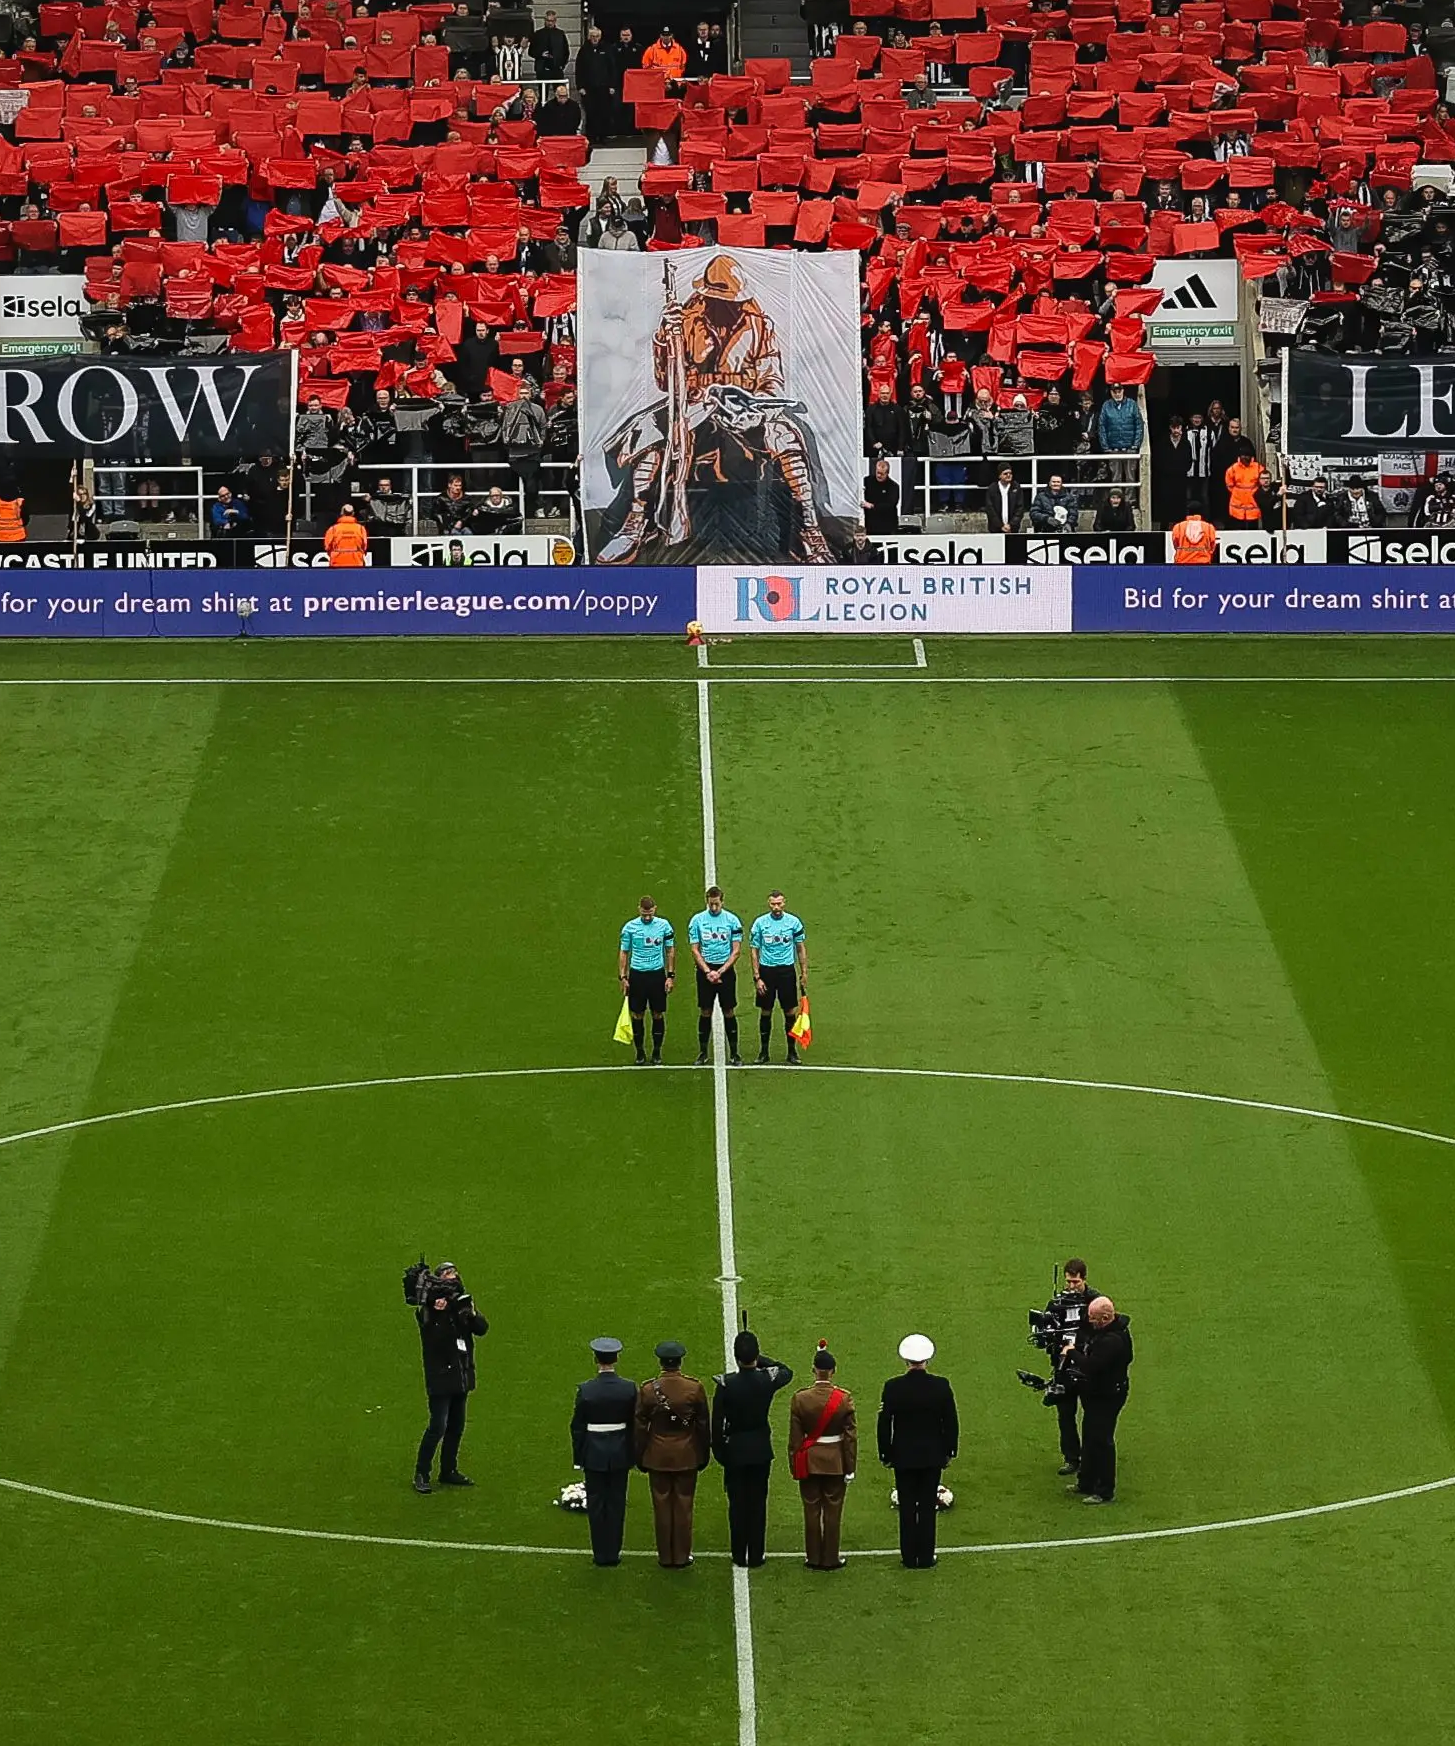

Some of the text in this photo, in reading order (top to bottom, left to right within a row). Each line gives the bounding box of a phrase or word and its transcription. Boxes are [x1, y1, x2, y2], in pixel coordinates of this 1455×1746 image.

[28, 296, 80, 317] sela
[1153, 326, 1232, 336] Emergency exit
[2, 343, 81, 354] Emergency exit
[897, 534, 983, 564] sela
[1065, 534, 1144, 564] sela
[826, 576, 1032, 595] ROYAL BRITISH
[1, 591, 38, 614] for
[47, 594, 103, 619] your
[114, 592, 191, 614] dream
[201, 590, 260, 614] shirt
[269, 593, 293, 612] at
[303, 589, 658, 617] premierleague.com/poppy
[1125, 587, 1161, 608] Bid
[1173, 587, 1209, 608] for
[1218, 590, 1275, 614] your
[1285, 587, 1361, 609] dream
[1372, 586, 1429, 609] shirt
[826, 603, 928, 621] LEGION
